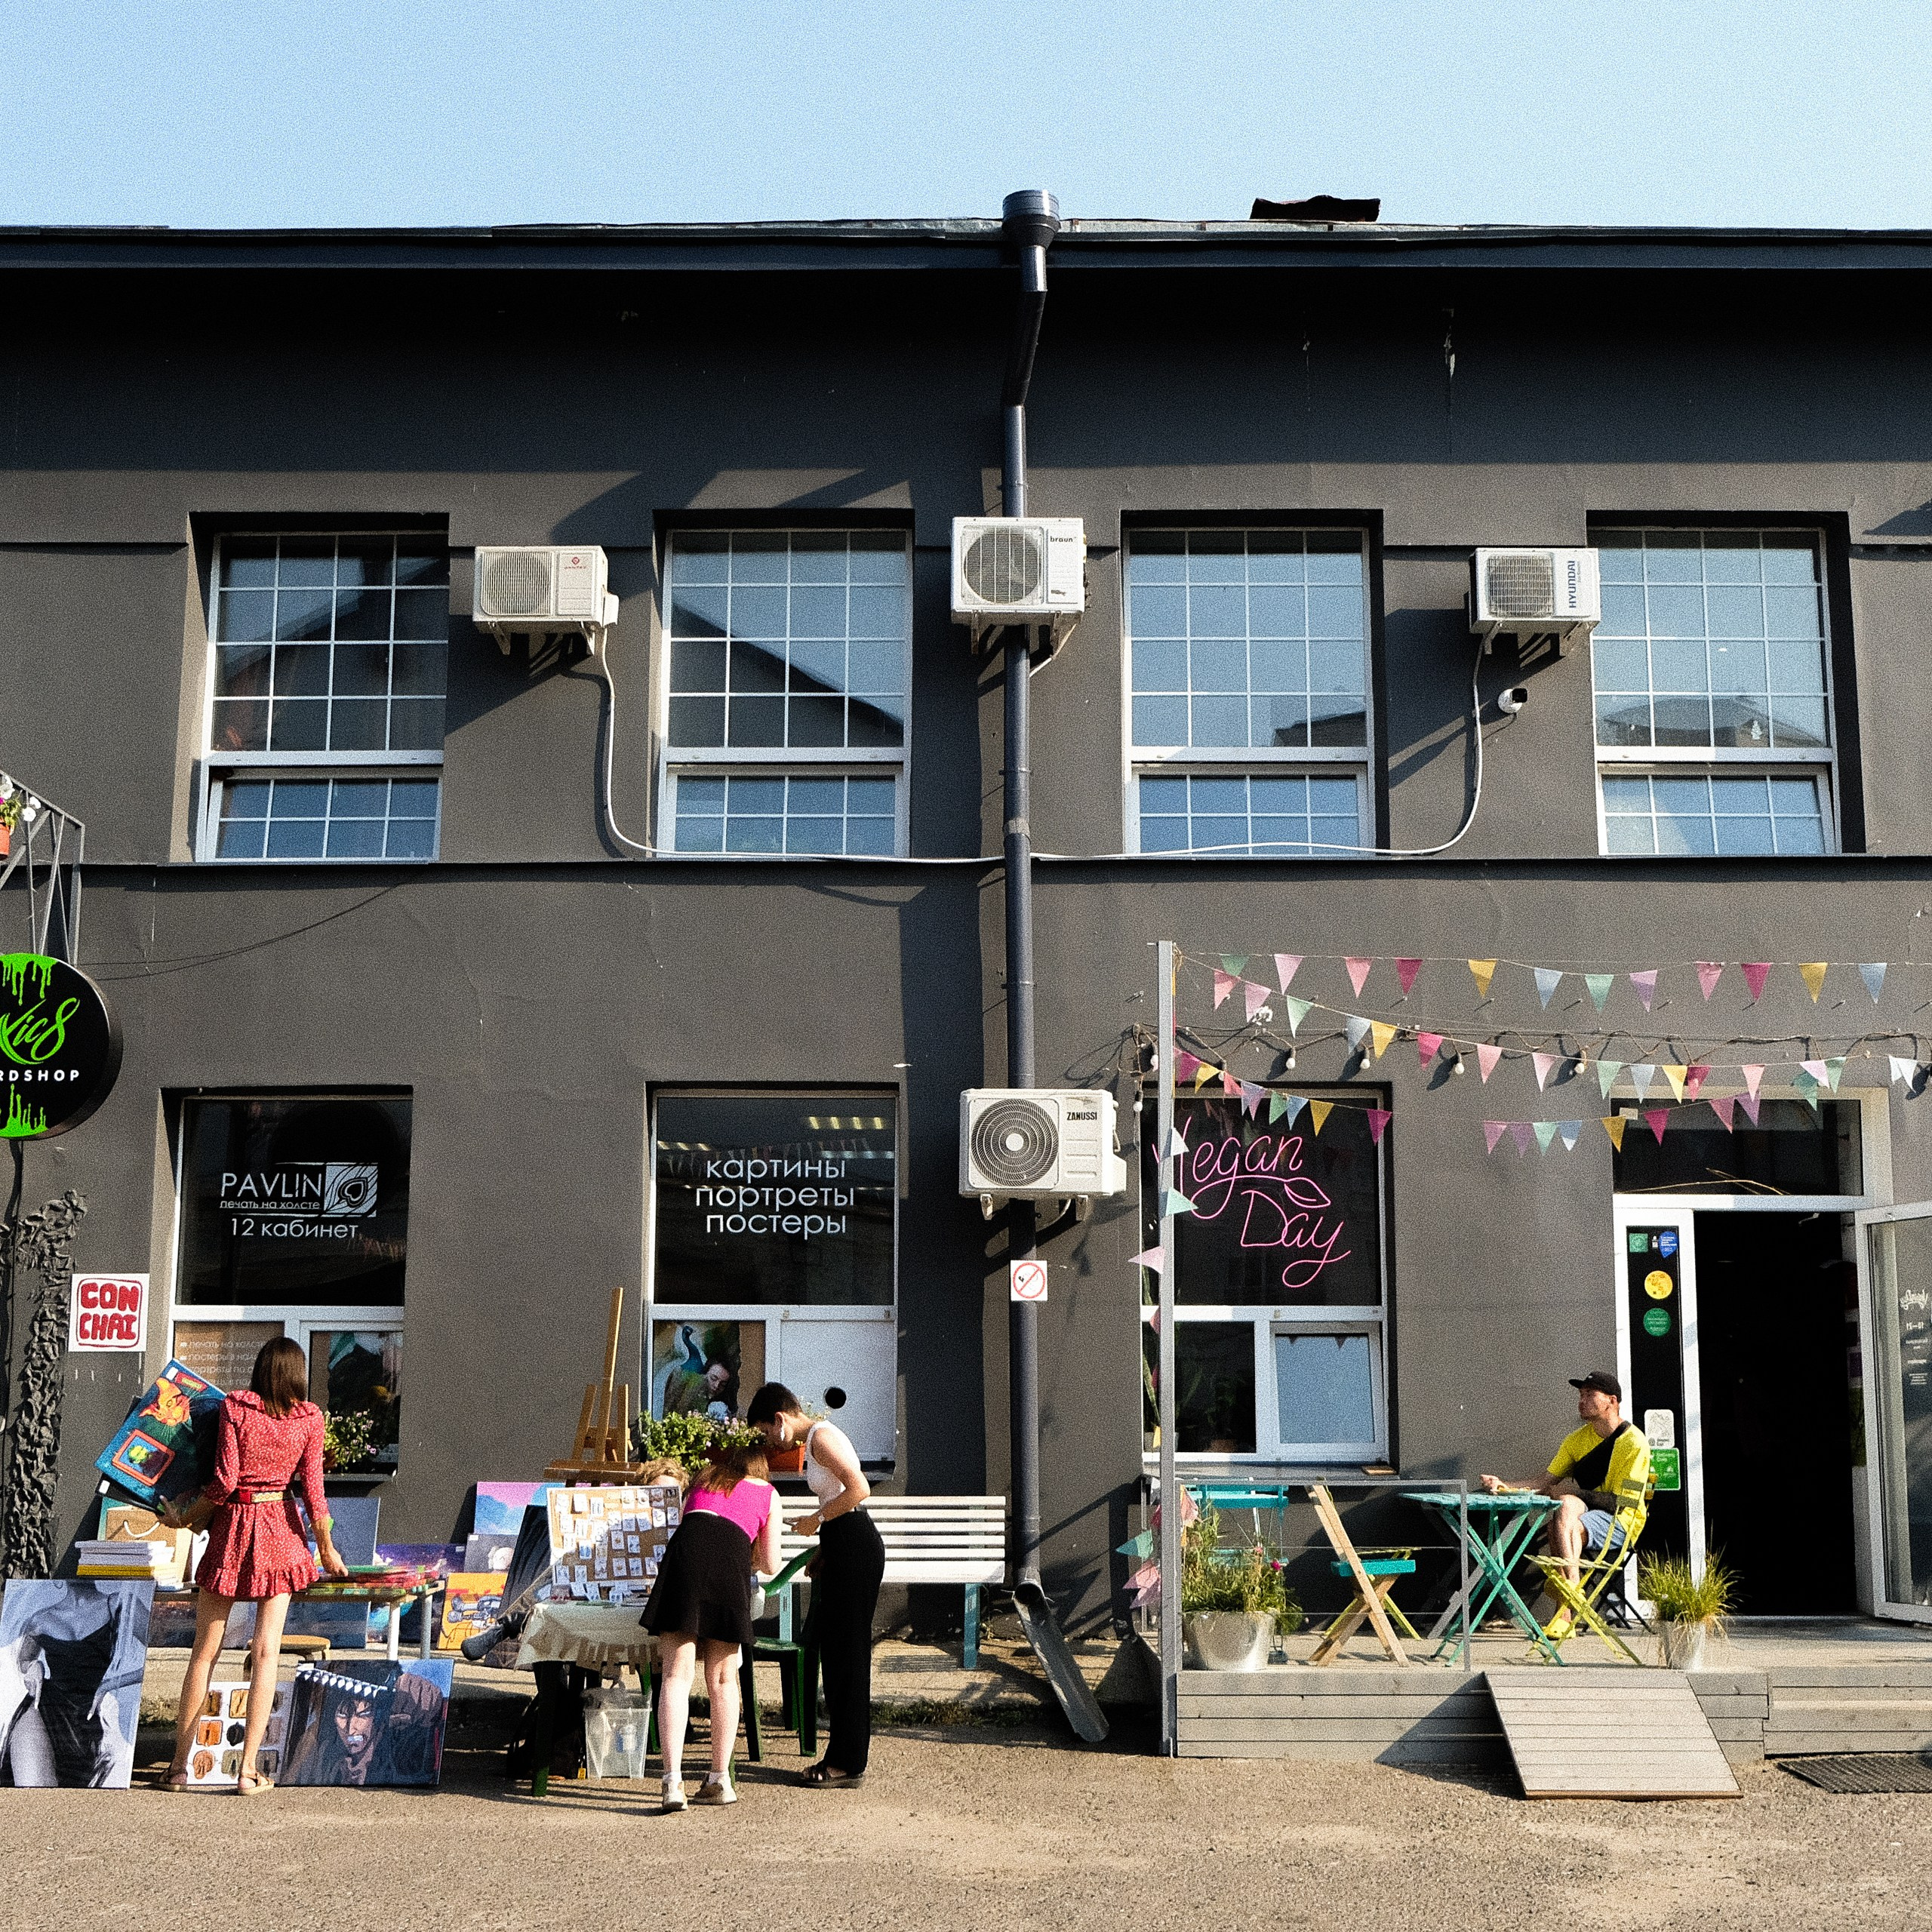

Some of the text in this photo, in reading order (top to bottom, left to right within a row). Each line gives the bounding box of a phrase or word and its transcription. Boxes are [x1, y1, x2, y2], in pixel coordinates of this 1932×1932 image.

[1567, 560, 1577, 608] HYUNDAI
[1066, 1112, 1097, 1121] ZANUSSI
[706, 1158, 845, 1184] картины
[221, 1173, 322, 1198] PAVLIN
[220, 1201, 321, 1209] печать на холсте
[695, 1186, 854, 1212] портреты
[232, 1218, 358, 1238] 12 кабинет
[706, 1211, 846, 1241] постеры
[1240, 1190, 1351, 1287] Day
[81, 1282, 140, 1312] CON
[79, 1312, 137, 1340] CHAI
